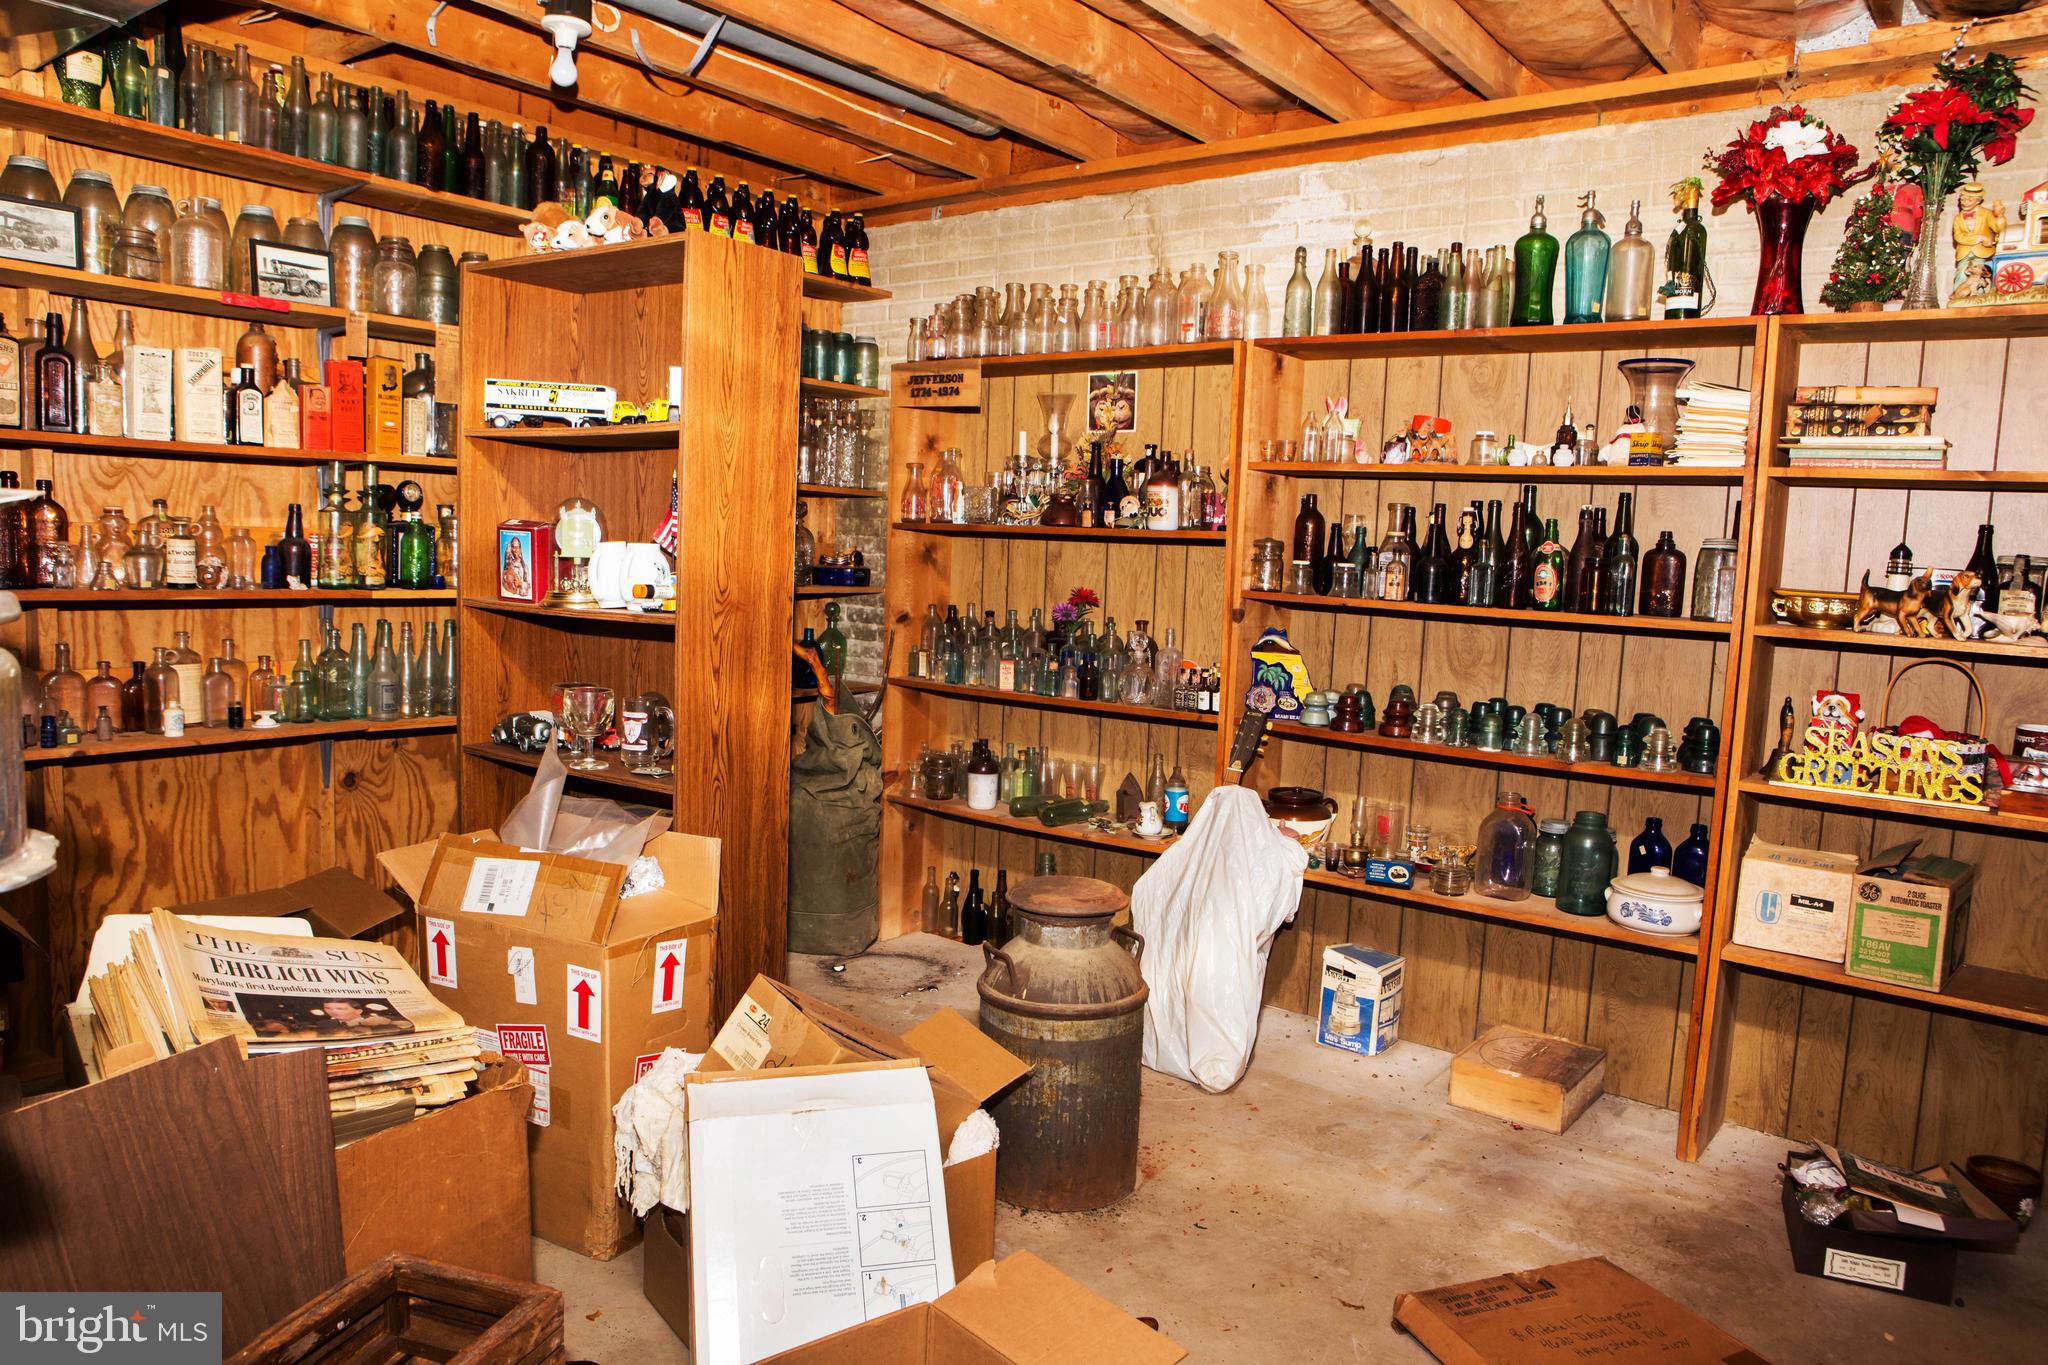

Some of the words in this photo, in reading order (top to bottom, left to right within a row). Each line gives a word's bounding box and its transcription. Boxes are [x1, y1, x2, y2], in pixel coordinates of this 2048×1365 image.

[907, 373, 964, 385] JEFFERSON
[1779, 751, 1984, 805] GREETINGS
[1890, 895, 1920, 908] AUTOMATIC
[1919, 900, 1942, 911] TOASTER
[1907, 890, 1912, 898] 2
[1912, 890, 1927, 900] SLICE
[186, 930, 256, 955] THE
[326, 949, 384, 964] SUN
[210, 957, 323, 983] EHRLICH
[325, 969, 390, 985] WINS
[580, 970, 590, 978] SIDE
[192, 972, 244, 988] Maryland's
[246, 982, 266, 990] first
[268, 983, 321, 994] Republican
[323, 987, 362, 995] governor
[502, 1032, 544, 1050] FRAGILE
[533, 1053, 546, 1062] CARE
